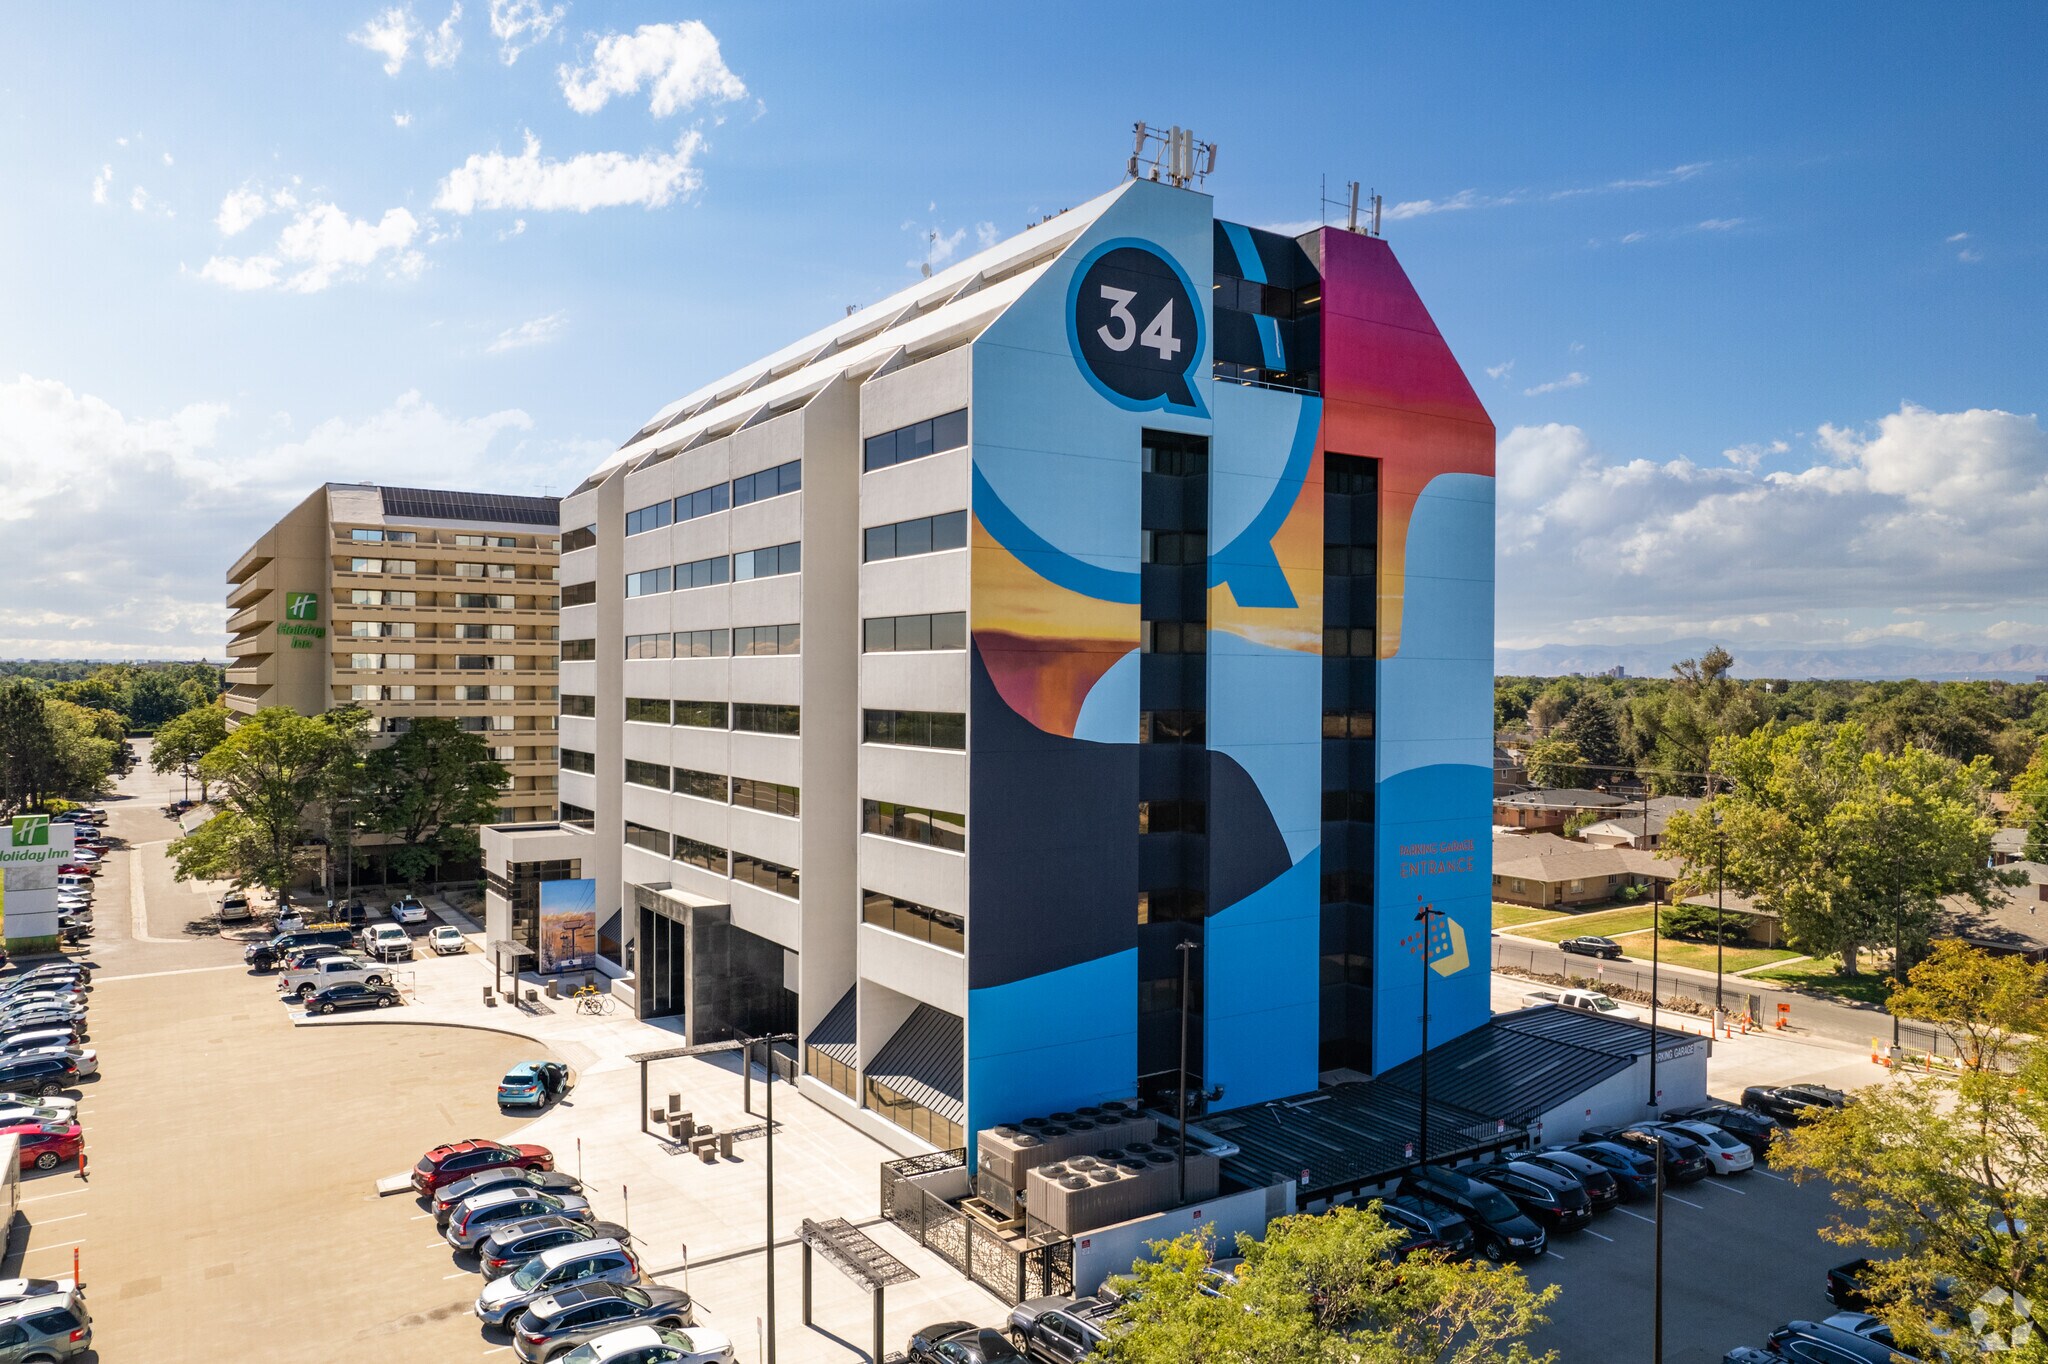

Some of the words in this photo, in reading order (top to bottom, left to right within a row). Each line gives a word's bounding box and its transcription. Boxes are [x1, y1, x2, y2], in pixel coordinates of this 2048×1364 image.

[1097, 284, 1181, 361] 34
[277, 622, 326, 639] Holiday
[291, 636, 313, 649] Inn
[48, 847, 69, 859] Inn
[1399, 842, 1438, 856] PARKING
[1439, 839, 1475, 853] GARAGE
[1400, 855, 1475, 879] ENTRANCE
[1673, 1043, 1694, 1058] GARAGE
